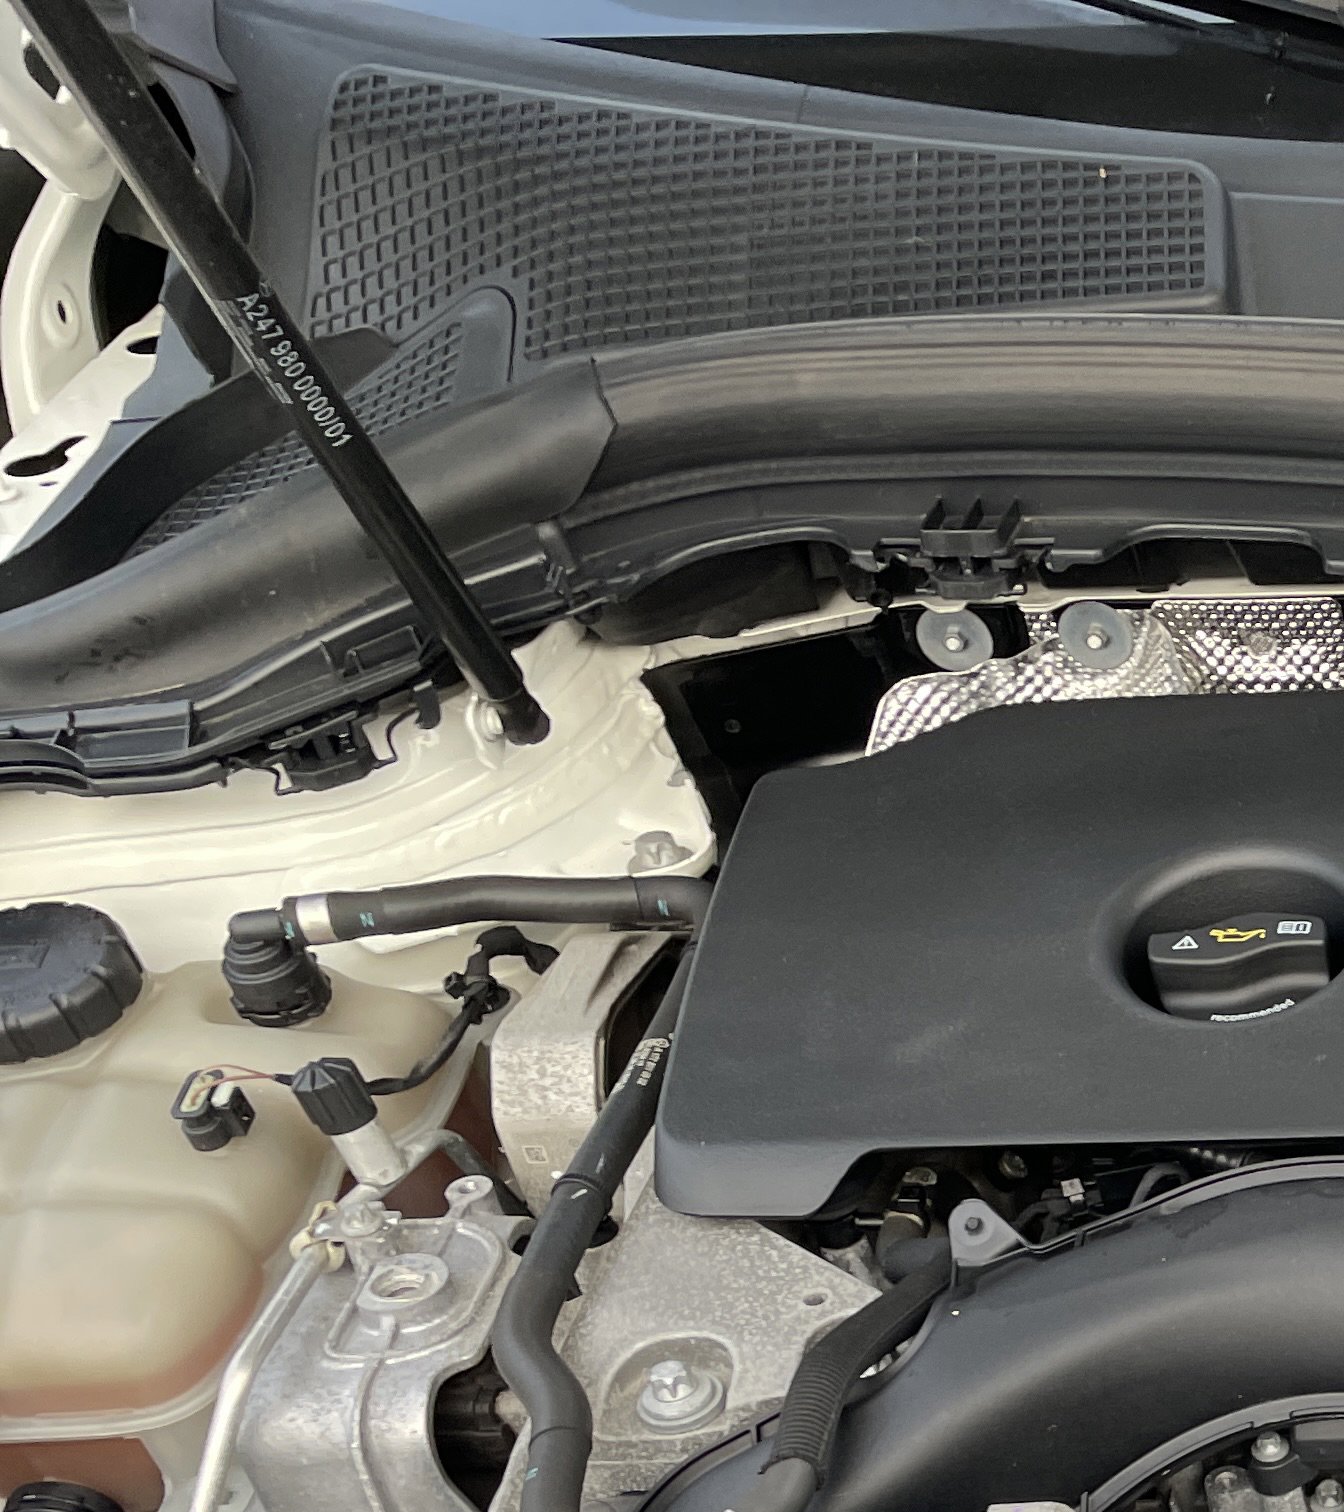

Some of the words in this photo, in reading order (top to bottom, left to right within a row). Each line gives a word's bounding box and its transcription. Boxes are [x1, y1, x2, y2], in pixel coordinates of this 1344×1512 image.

[237, 293, 284, 340] A247
[270, 340, 306, 378] 980
[293, 375, 353, 447] 0000/01
[1210, 998, 1295, 1022] recommended
